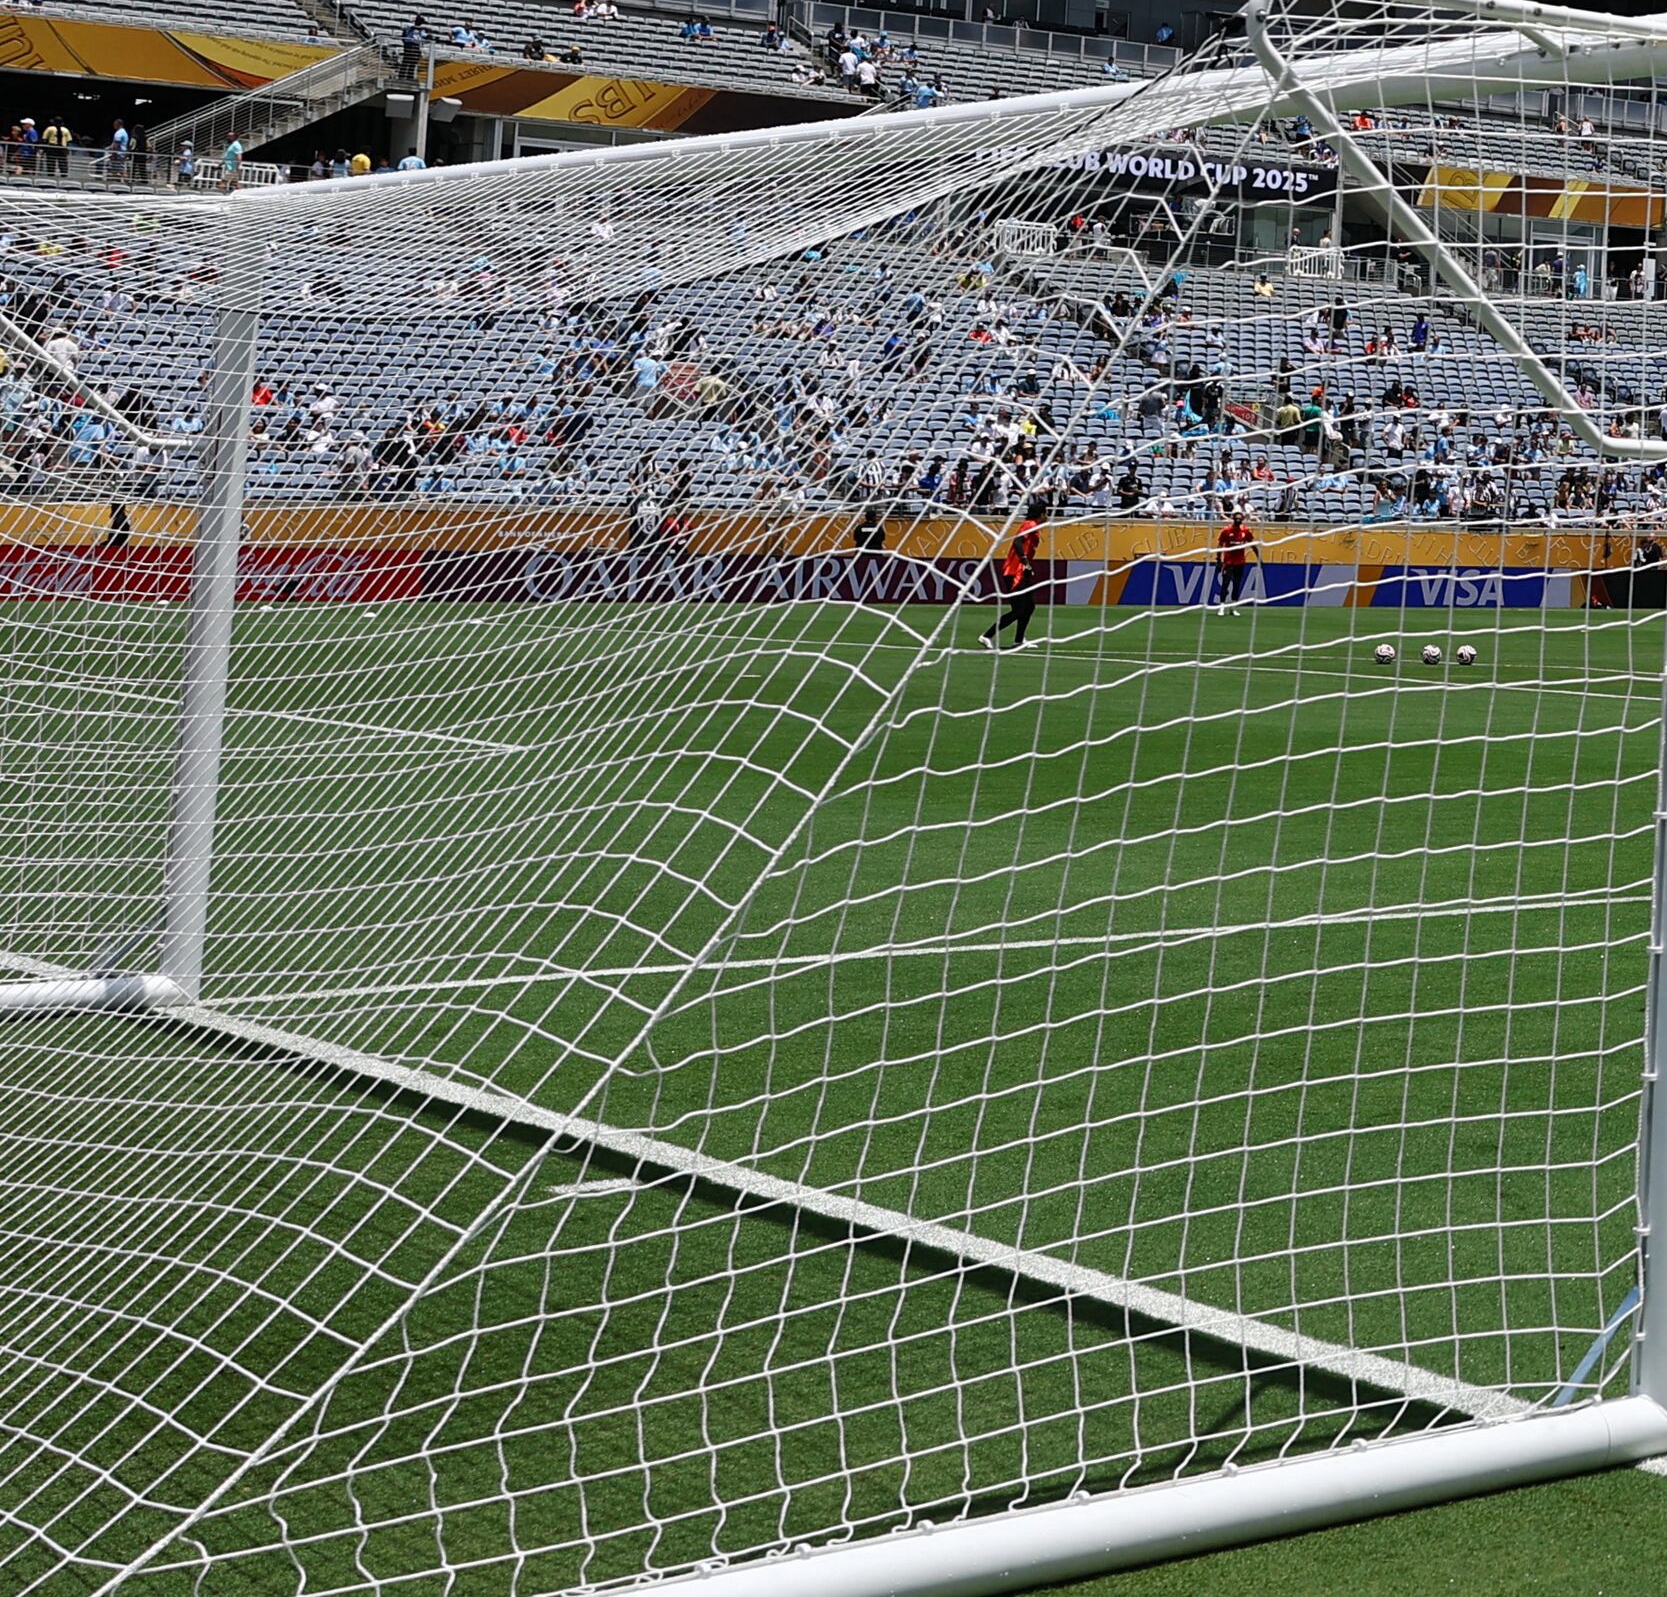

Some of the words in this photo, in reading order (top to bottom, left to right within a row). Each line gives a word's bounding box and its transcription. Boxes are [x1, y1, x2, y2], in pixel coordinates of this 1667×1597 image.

[1105, 150, 1195, 181] WORLD
[1199, 161, 1247, 186] CUP
[525, 553, 725, 601] QATAR
[752, 557, 984, 602] AIRWAYS
[1409, 568, 1505, 606] VISA
